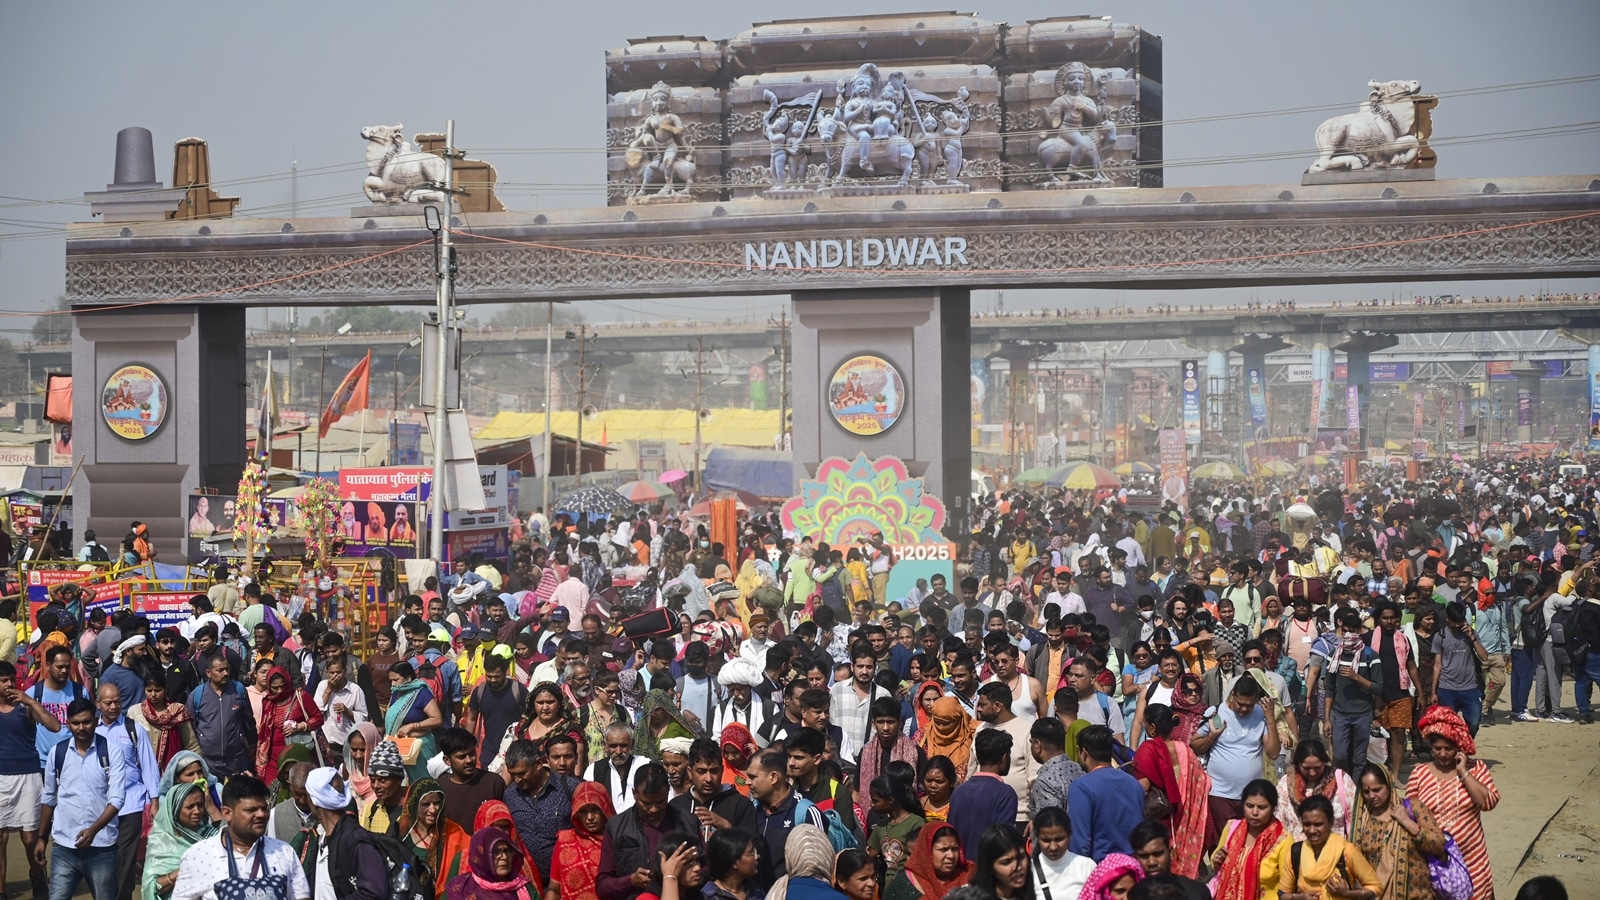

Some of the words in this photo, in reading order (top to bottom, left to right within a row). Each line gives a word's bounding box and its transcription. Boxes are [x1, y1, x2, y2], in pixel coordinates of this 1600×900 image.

[745, 239, 853, 271] NANDI
[862, 236, 969, 266] DWAR
[856, 422, 878, 430] 2025
[345, 475, 388, 485] यातायात
[389, 472, 418, 488] पुलिस
